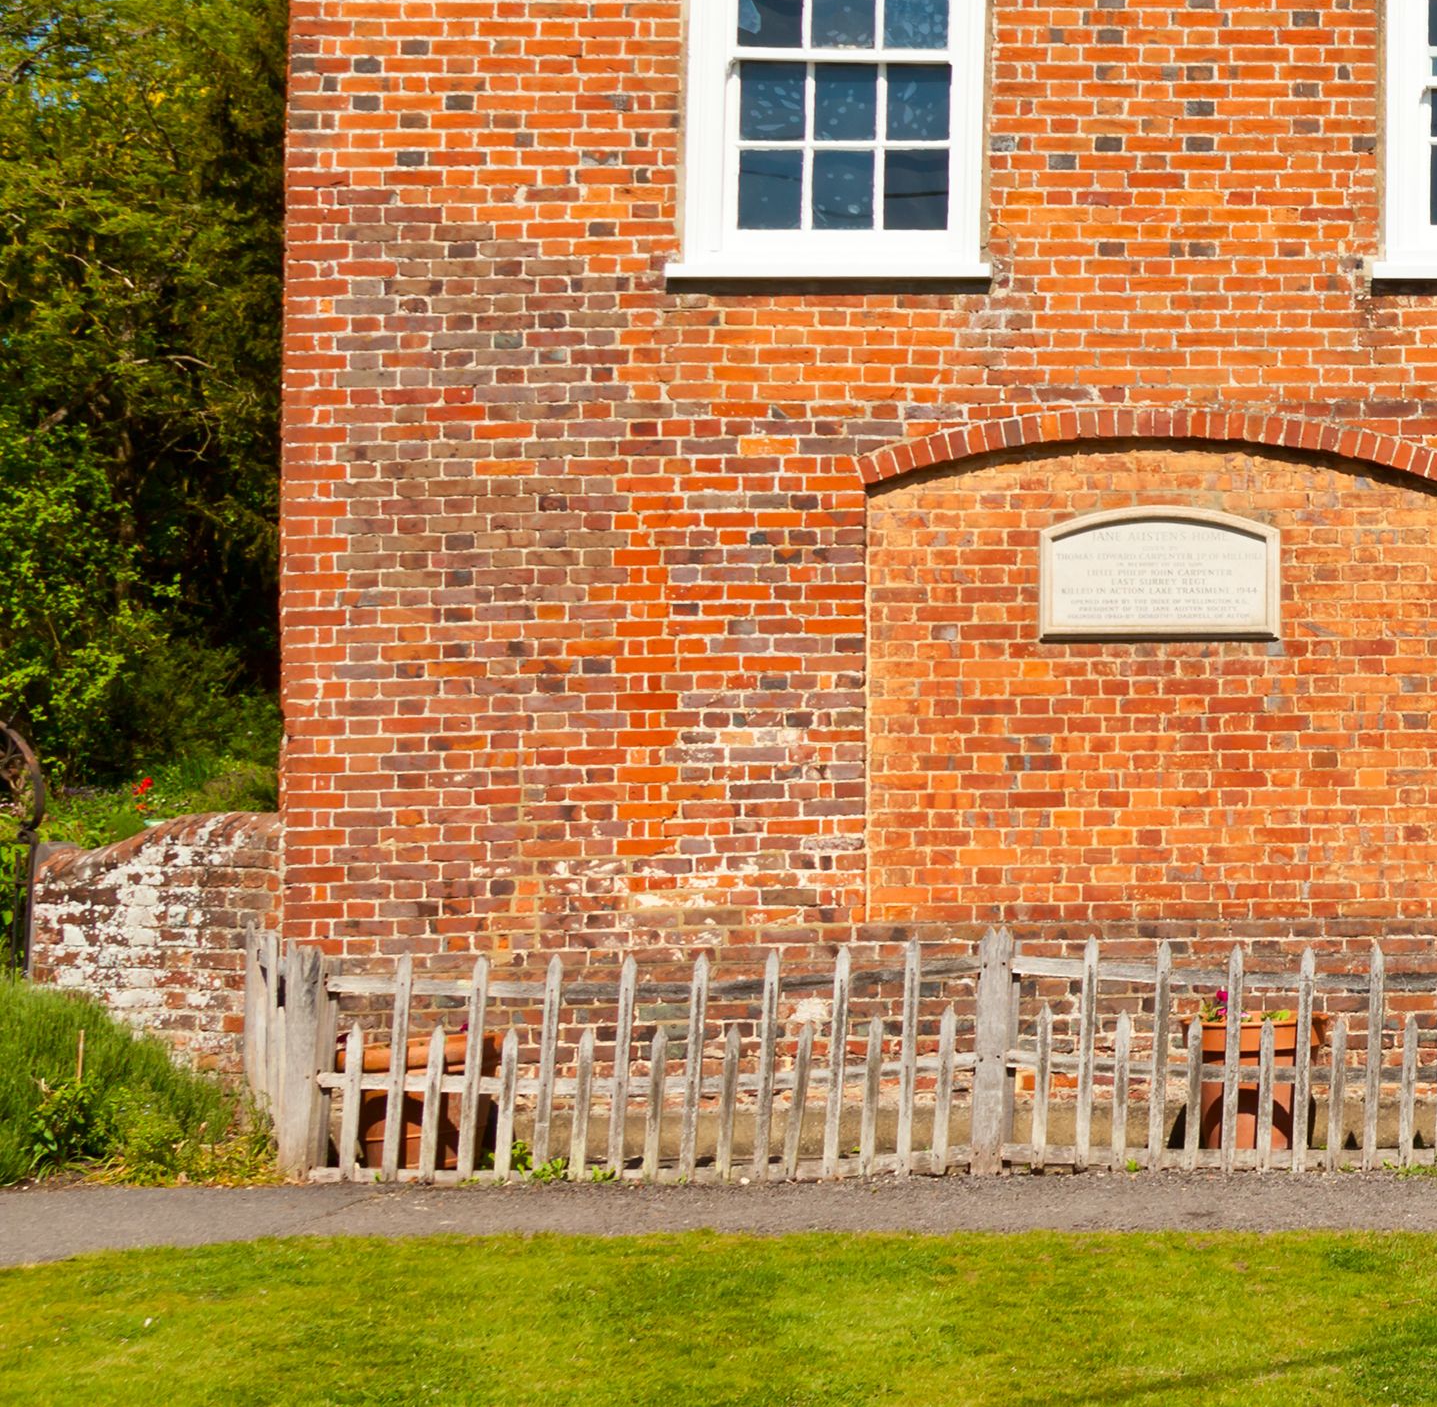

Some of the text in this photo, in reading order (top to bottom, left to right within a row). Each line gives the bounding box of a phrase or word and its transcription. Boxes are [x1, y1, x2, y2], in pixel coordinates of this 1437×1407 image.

[1092, 530, 1120, 542] JANE
[1191, 530, 1227, 542] HOME
[1096, 552, 1136, 561] EDWARD
[1138, 552, 1192, 561] CARPENTER
[1150, 569, 1174, 577] JOHN
[1177, 569, 1232, 577] CARPENTER
[1111, 578, 1134, 586] EAST
[1138, 578, 1178, 586] SURREY
[1061, 587, 1094, 595] KILLED
[1096, 587, 1106, 595] IN
[1110, 587, 1145, 595] ACTION
[1149, 587, 1172, 595] LAKE
